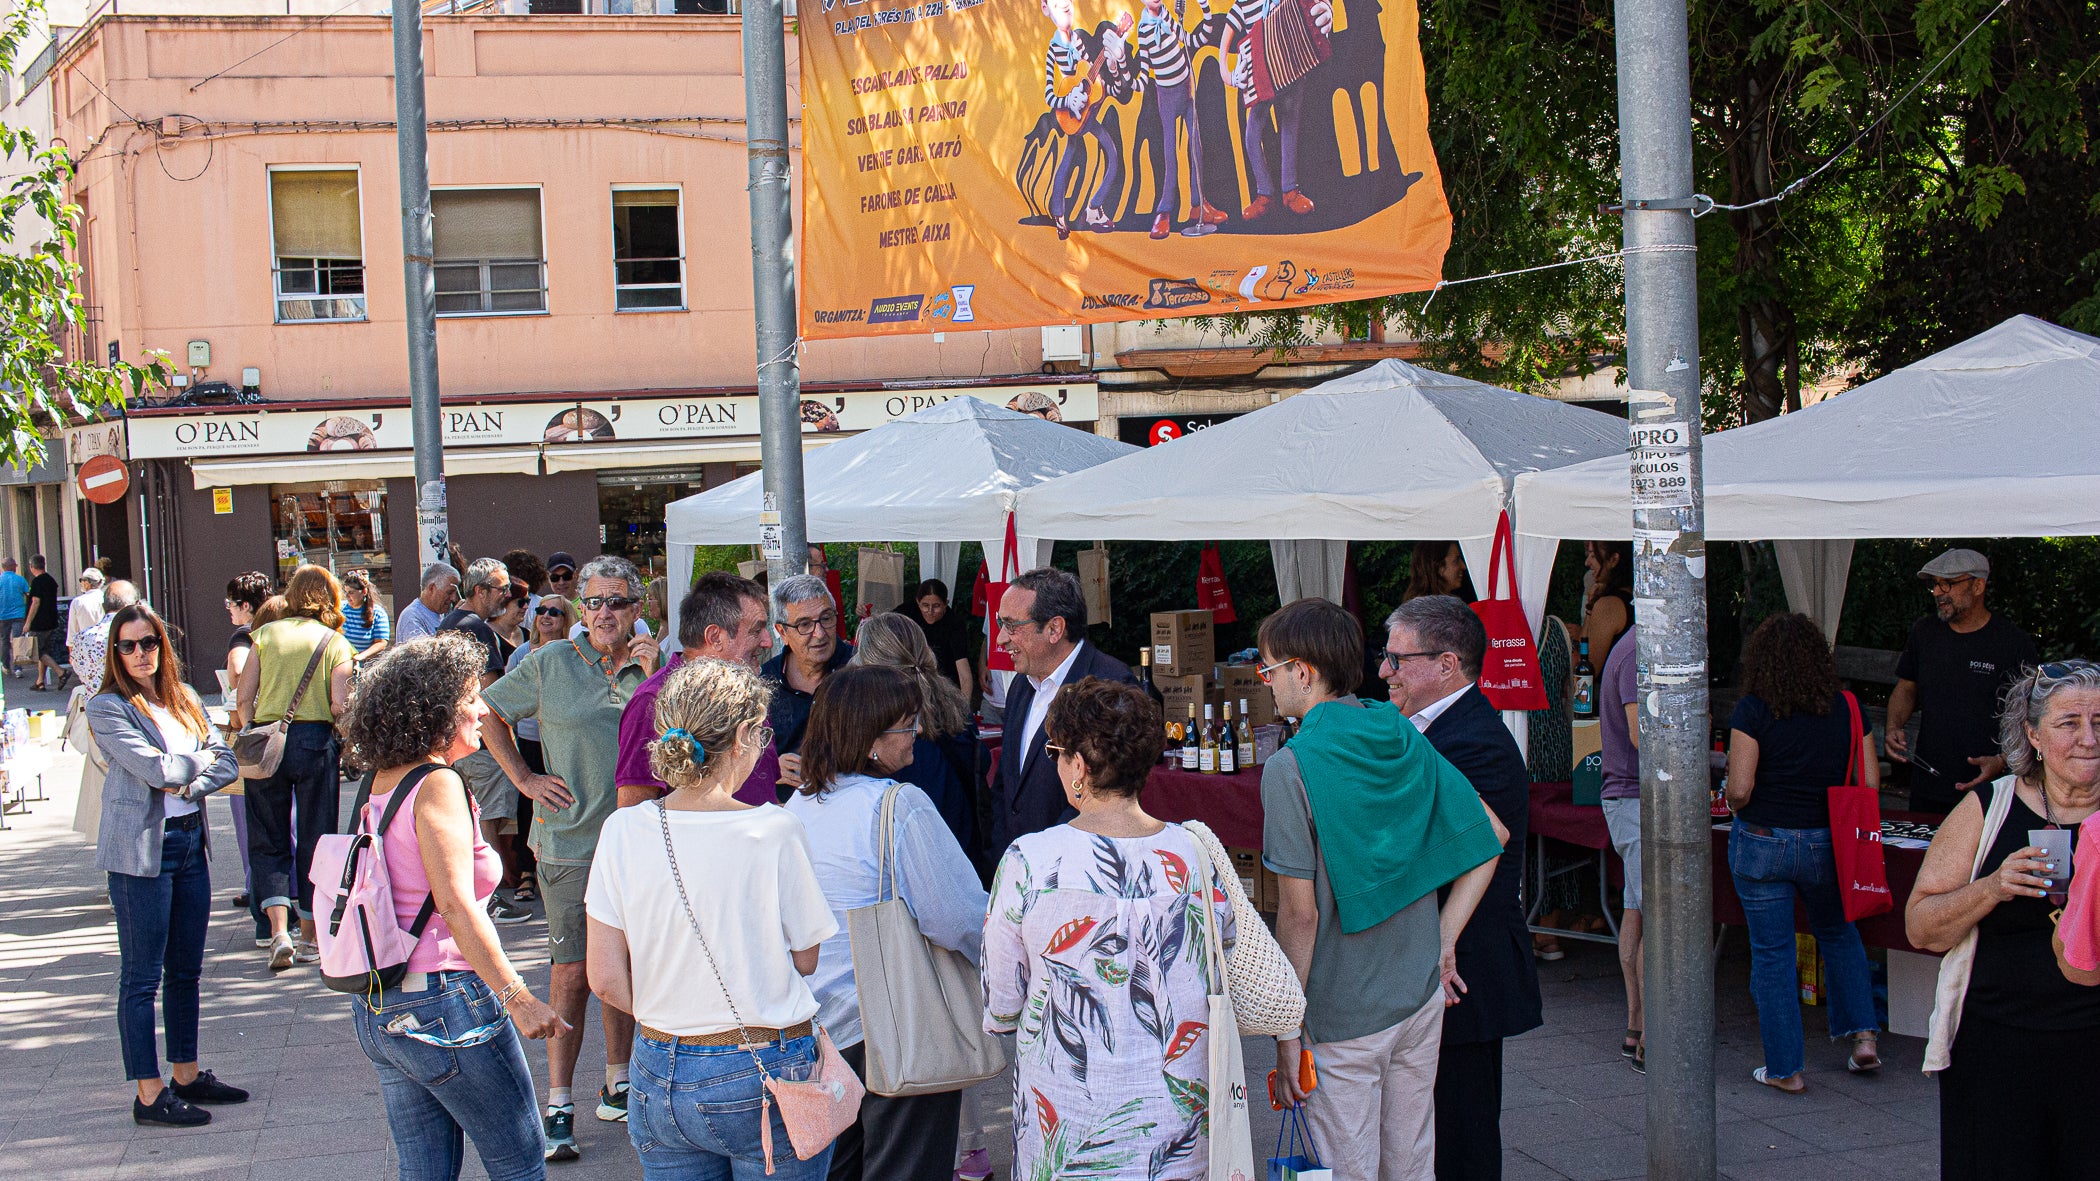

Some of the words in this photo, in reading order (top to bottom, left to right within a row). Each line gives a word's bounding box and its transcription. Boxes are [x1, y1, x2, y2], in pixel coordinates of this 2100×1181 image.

[925, 3, 944, 17] 22H
[924, 61, 968, 81] PALAU
[904, 187, 921, 206] DE
[1163, 291, 1208, 306] Terrassa
[441, 411, 504, 433] 'PAN
[658, 403, 737, 426] O'PAN
[176, 420, 260, 444] O'PAN
[1658, 476, 1686, 488] 889
